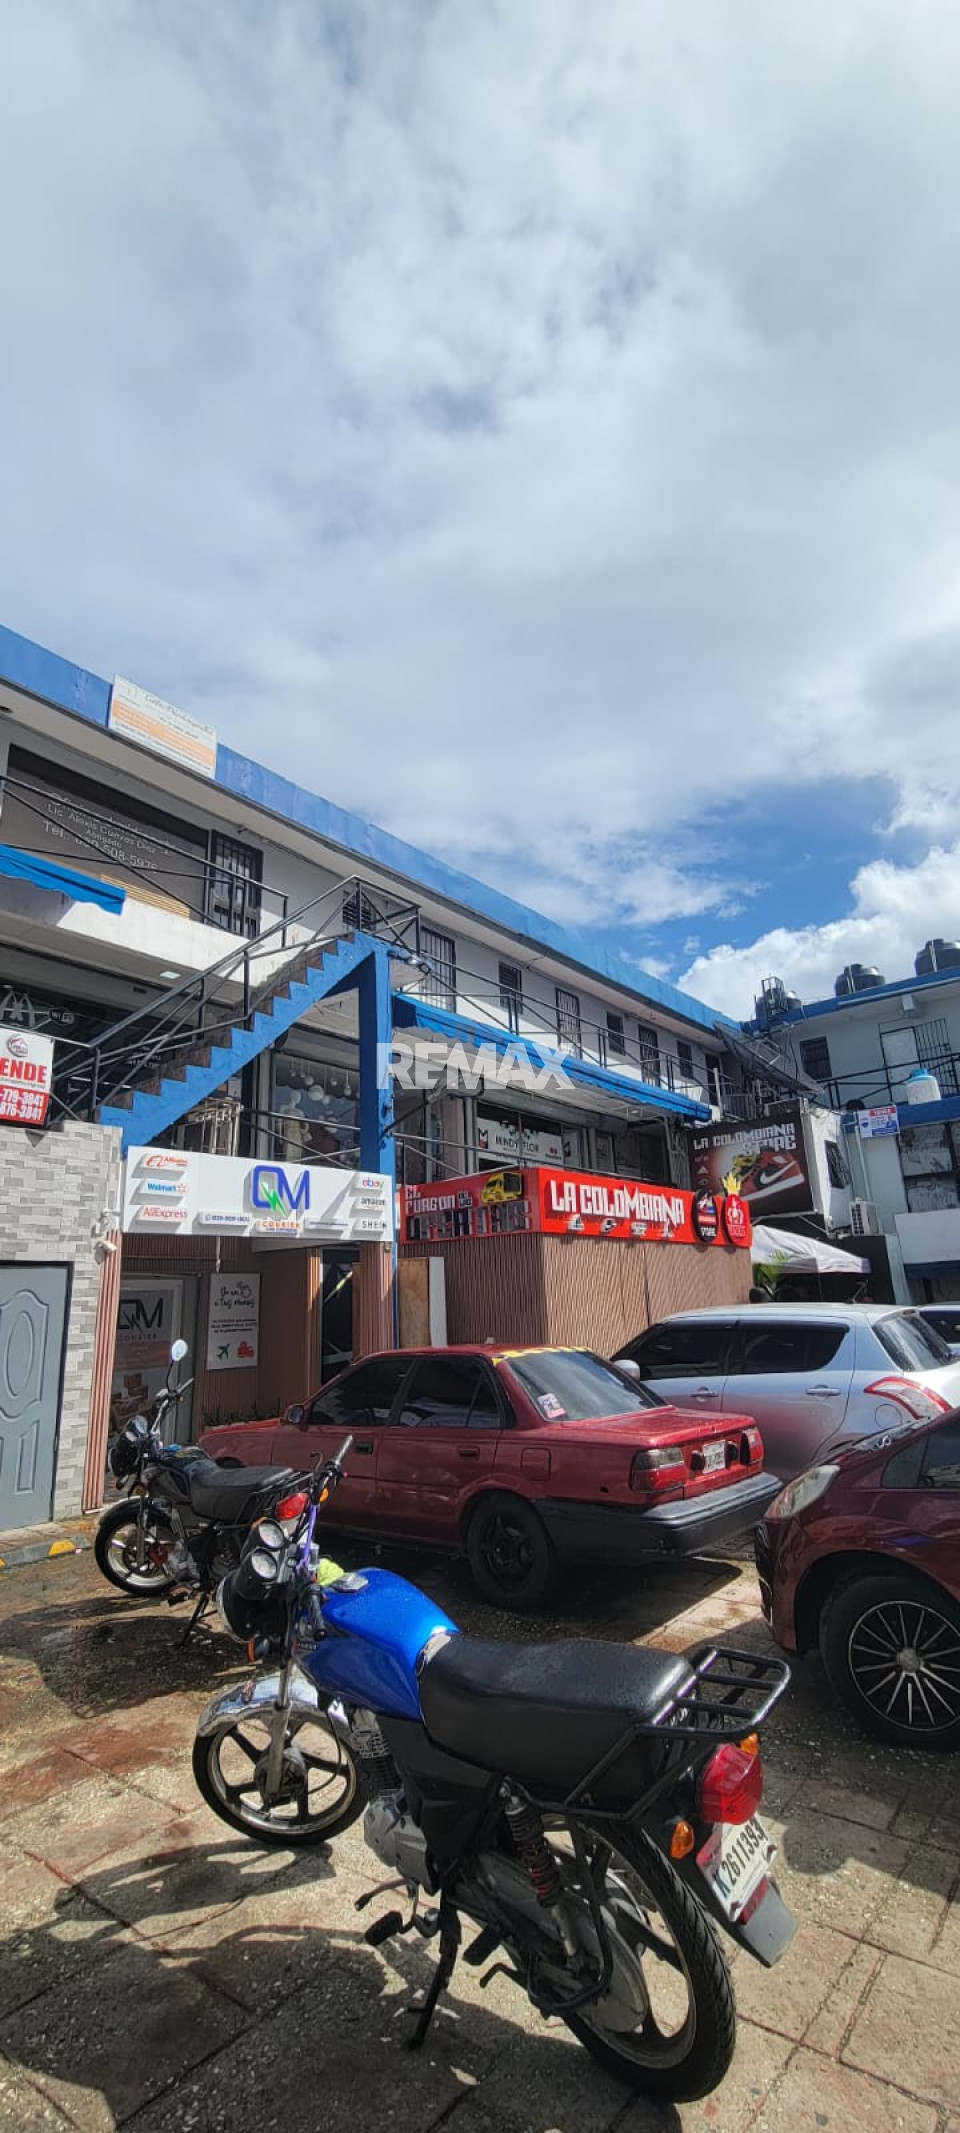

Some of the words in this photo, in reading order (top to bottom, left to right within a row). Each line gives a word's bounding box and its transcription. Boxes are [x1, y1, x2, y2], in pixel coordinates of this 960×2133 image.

[693, 1138, 709, 1150] LA
[712, 1123, 796, 1147] COLOMBIANA
[148, 1182, 177, 1193] Walmart
[143, 1207, 188, 1218] AliExpress
[550, 1180, 577, 1213] LA
[579, 1183, 686, 1228] COLOMBIANA
